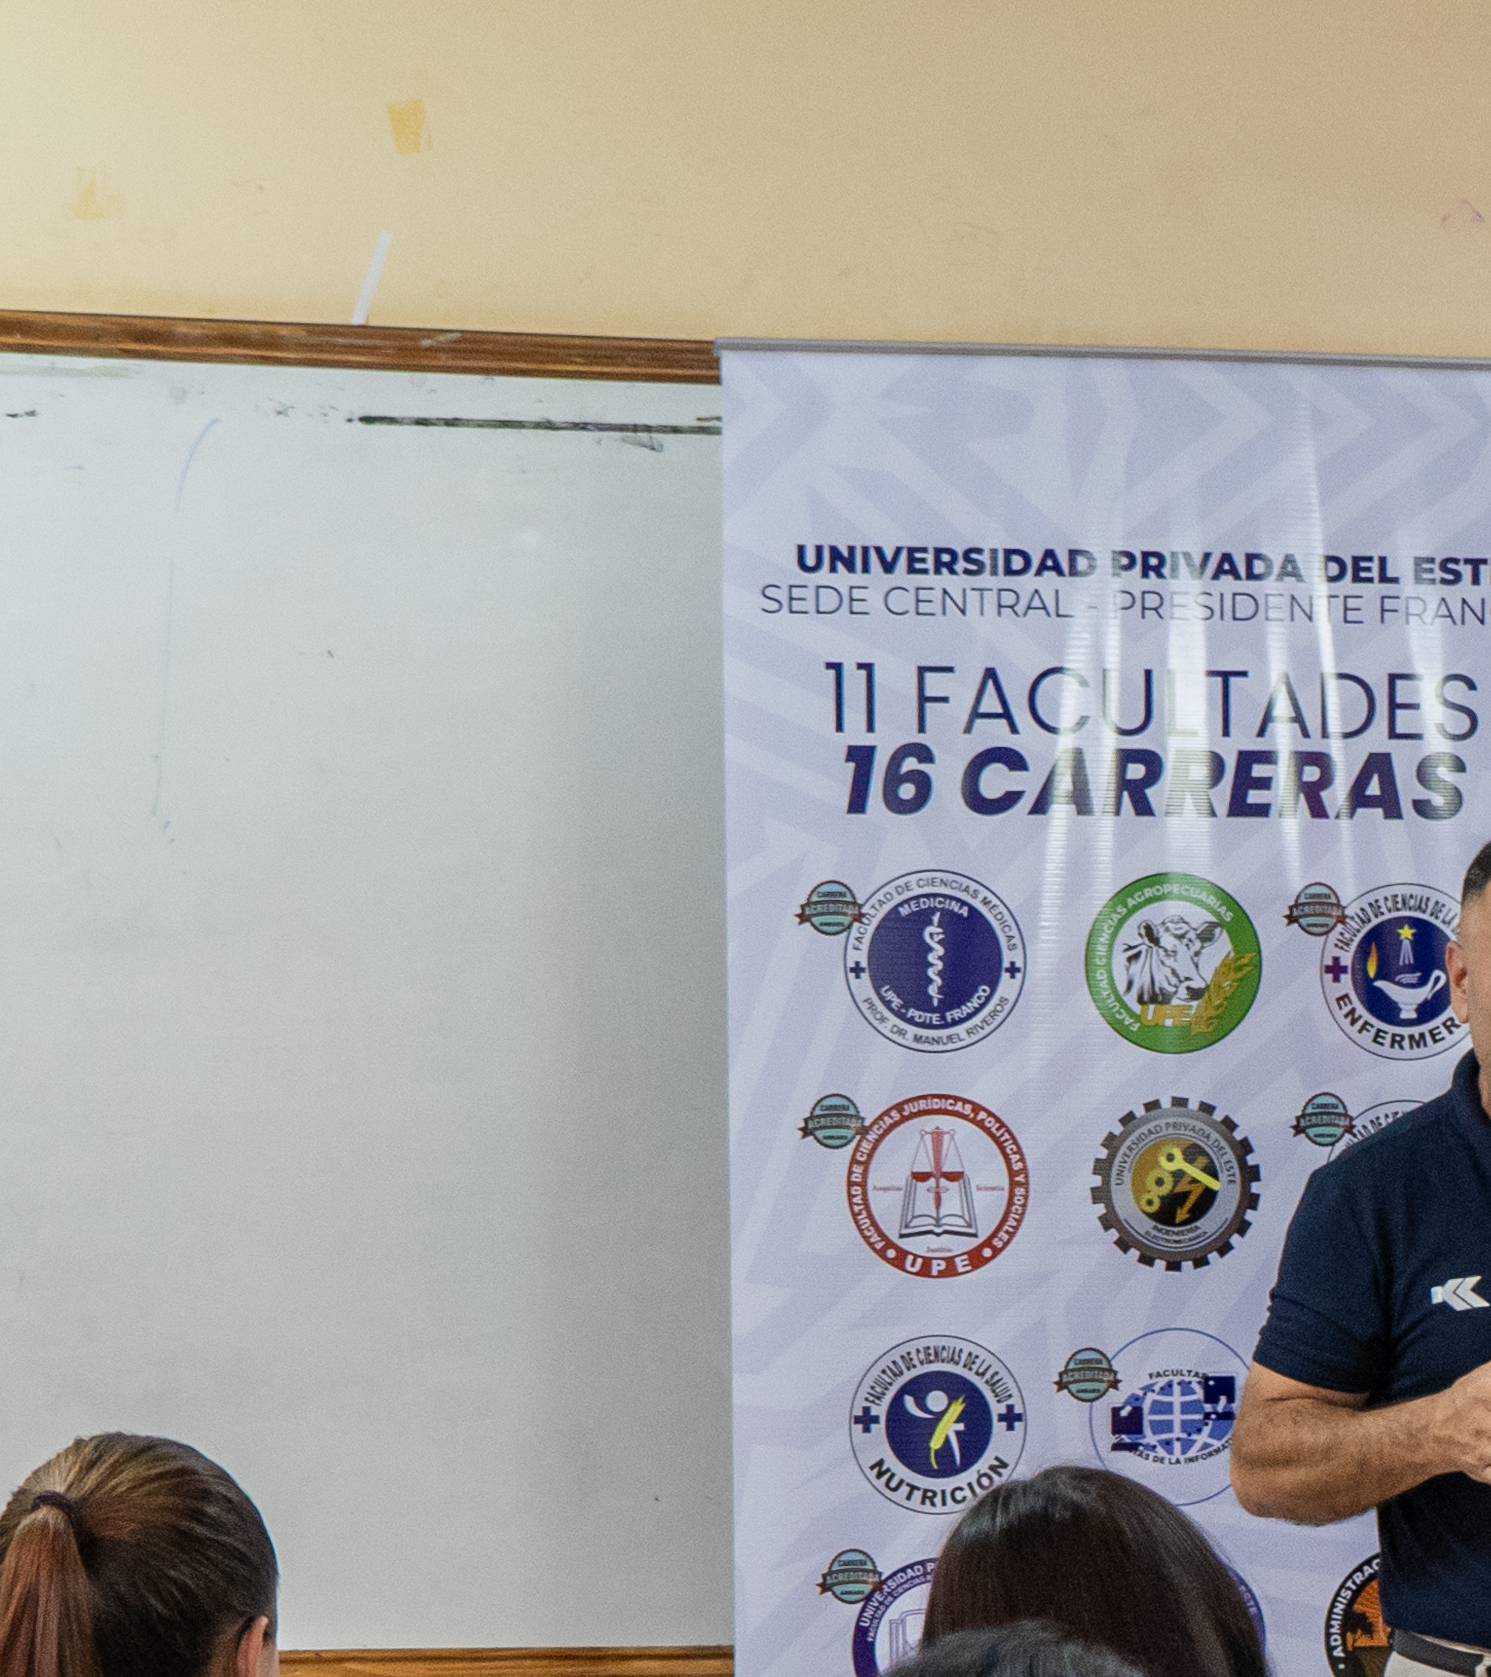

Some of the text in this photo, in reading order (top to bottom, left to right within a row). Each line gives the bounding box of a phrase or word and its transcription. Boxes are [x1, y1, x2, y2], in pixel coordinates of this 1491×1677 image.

[795, 543, 1097, 579] UNIVERSIDAD
[1112, 549, 1305, 583] PRIVADA
[1323, 553, 1398, 586] DEL
[761, 583, 870, 617] SEDE
[884, 585, 1075, 620] CENTRAL
[1115, 589, 1367, 624] PRESIDENTE
[824, 660, 1481, 742] 11 FACULTADES
[844, 741, 1468, 821] 16 CARRERAS
[852, 877, 1018, 952] FACULTAD DE CIENCIAS MÉDICAS
[898, 897, 969, 918] MEDICINA
[1095, 905, 1128, 966] CIENCIAS
[1126, 883, 1234, 923] AGROPECUARIAS
[1334, 908, 1371, 953] FACULTAD
[1384, 893, 1431, 914] CIENCIAS
[881, 985, 904, 1012] UPE
[946, 985, 991, 1023] FRANCO
[913, 1033, 966, 1045] MANUEL
[966, 996, 1009, 1037] RIVEROS
[1335, 992, 1461, 1051] ENFERMER
[858, 1110, 901, 1162] CIENCIAS
[1115, 1124, 1164, 1187] UNIVERSIDAD
[851, 1164, 864, 1182] DE
[850, 1186, 887, 1250] FACULTAD
[991, 1186, 1027, 1249] SOCIALES
[863, 1344, 1014, 1406] FACULTAD DE CIENCIAS DE LA SALUD
[869, 1455, 1010, 1508] NUTRICIÓN
[1328, 1558, 1380, 1658] ADMINISTRAC
